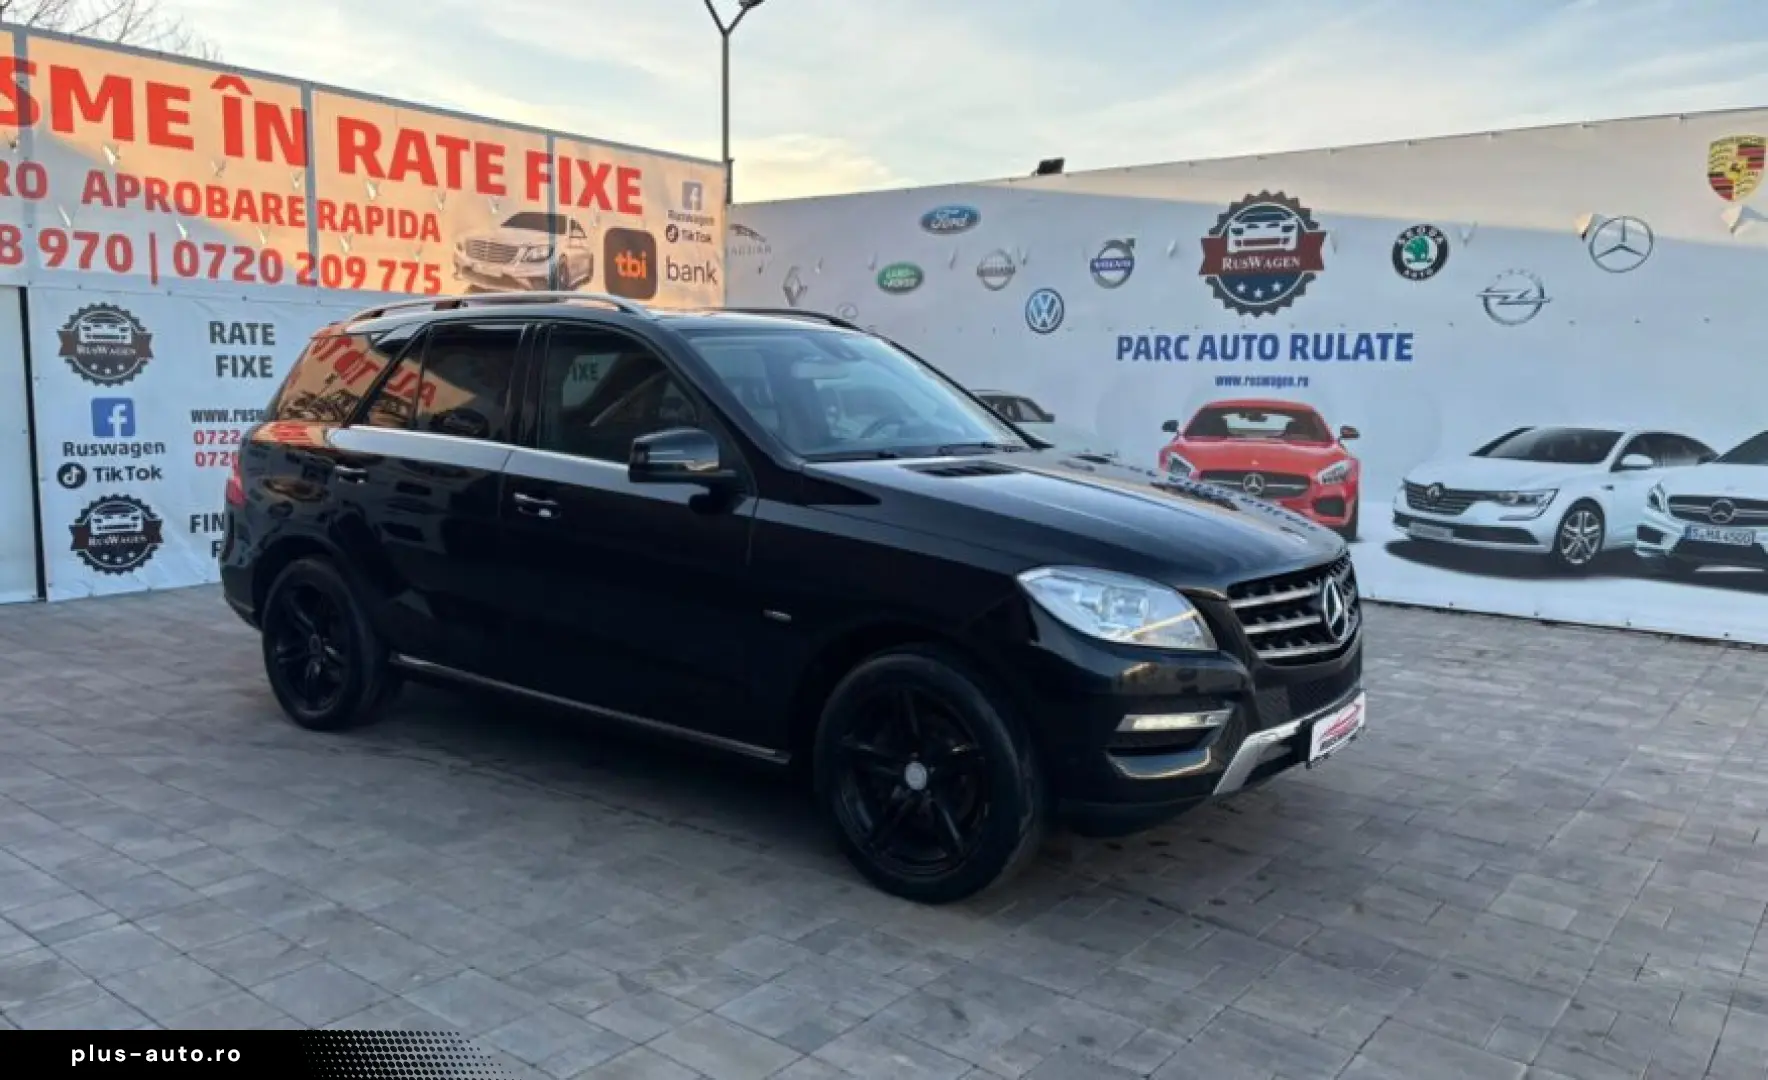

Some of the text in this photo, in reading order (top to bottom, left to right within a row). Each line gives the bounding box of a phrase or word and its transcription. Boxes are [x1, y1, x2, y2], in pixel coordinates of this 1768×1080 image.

[0, 55, 643, 216] SME ÎN RATE FIXE
[81, 168, 306, 228] APROBARE
[316, 198, 441, 243] RAPIDA
[38, 227, 134, 274] 970
[173, 240, 284, 285] 0720
[296, 252, 367, 290] 209
[377, 259, 442, 296] 775
[614, 249, 718, 285] tbi bank
[209, 320, 276, 346] RATE
[1116, 332, 1414, 362] PARC AUTO RULATE
[215, 354, 273, 378] FIXE
[63, 441, 166, 459] Ruswagen
[93, 464, 163, 483] TikTok
